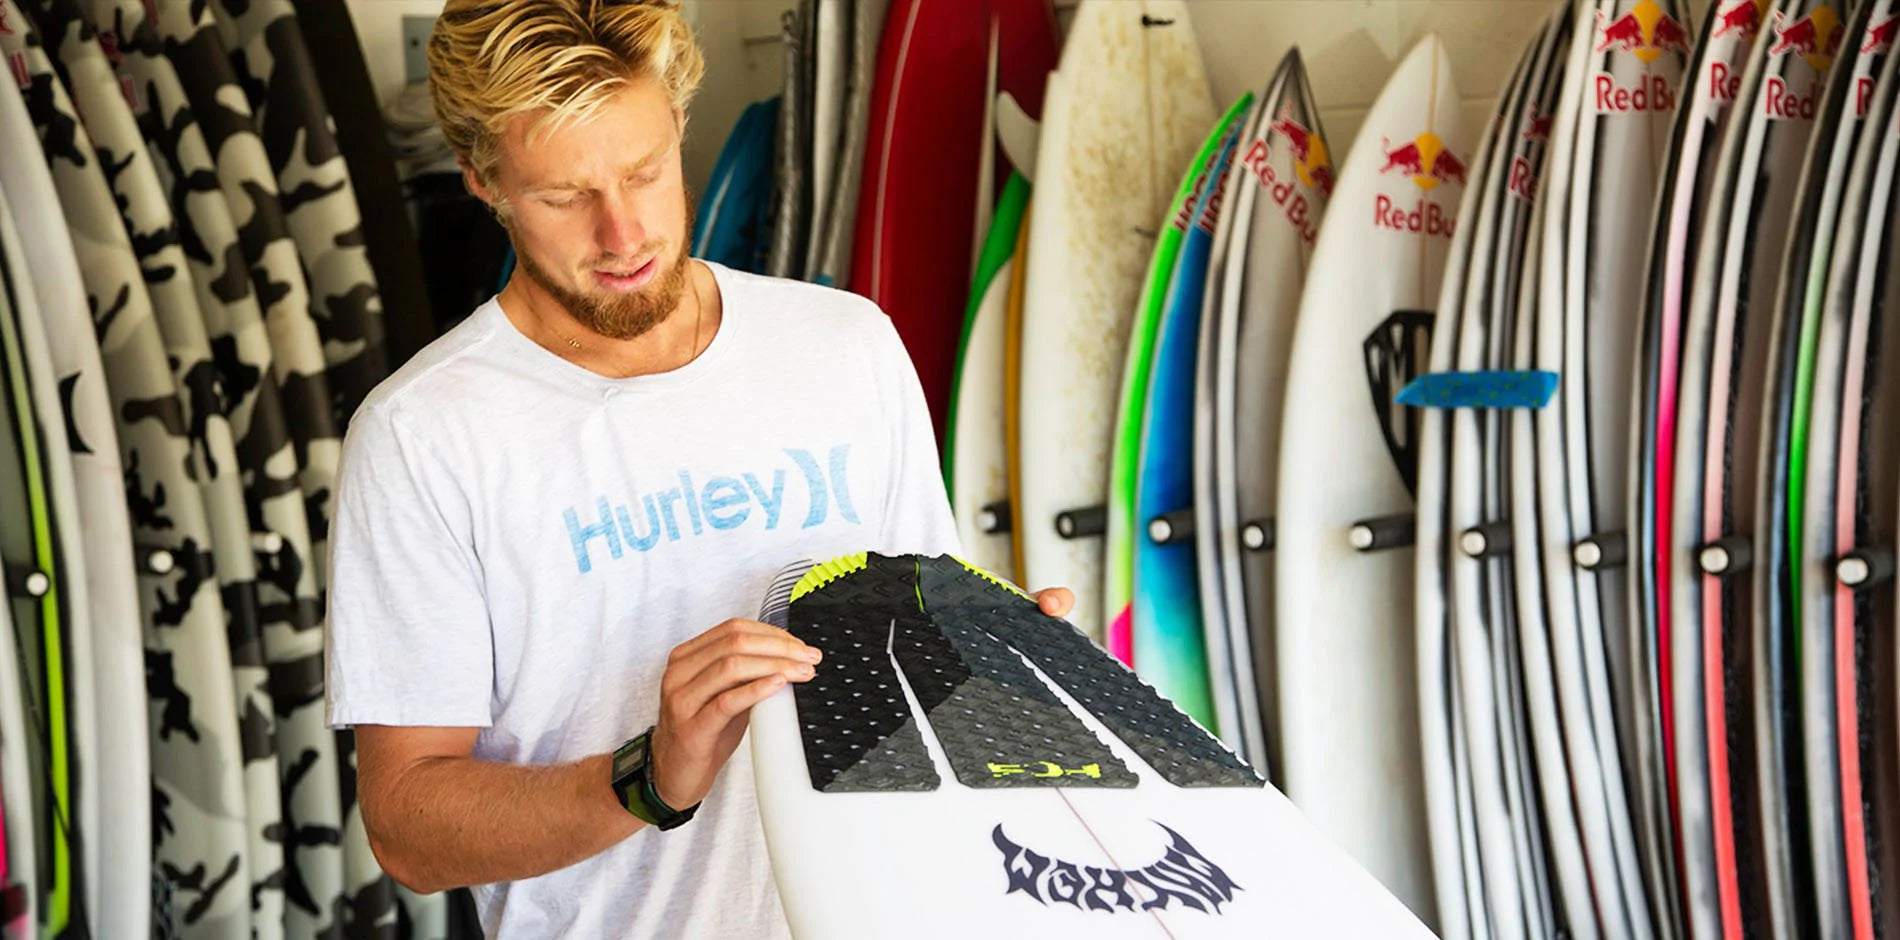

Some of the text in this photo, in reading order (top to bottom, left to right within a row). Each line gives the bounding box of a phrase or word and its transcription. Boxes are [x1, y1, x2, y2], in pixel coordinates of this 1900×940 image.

[1596, 74, 1648, 111] Red
[1766, 78, 1815, 120] Red
[1244, 139, 1294, 207] Red
[1375, 193, 1424, 233] Red
[562, 468, 786, 575] Hurley
